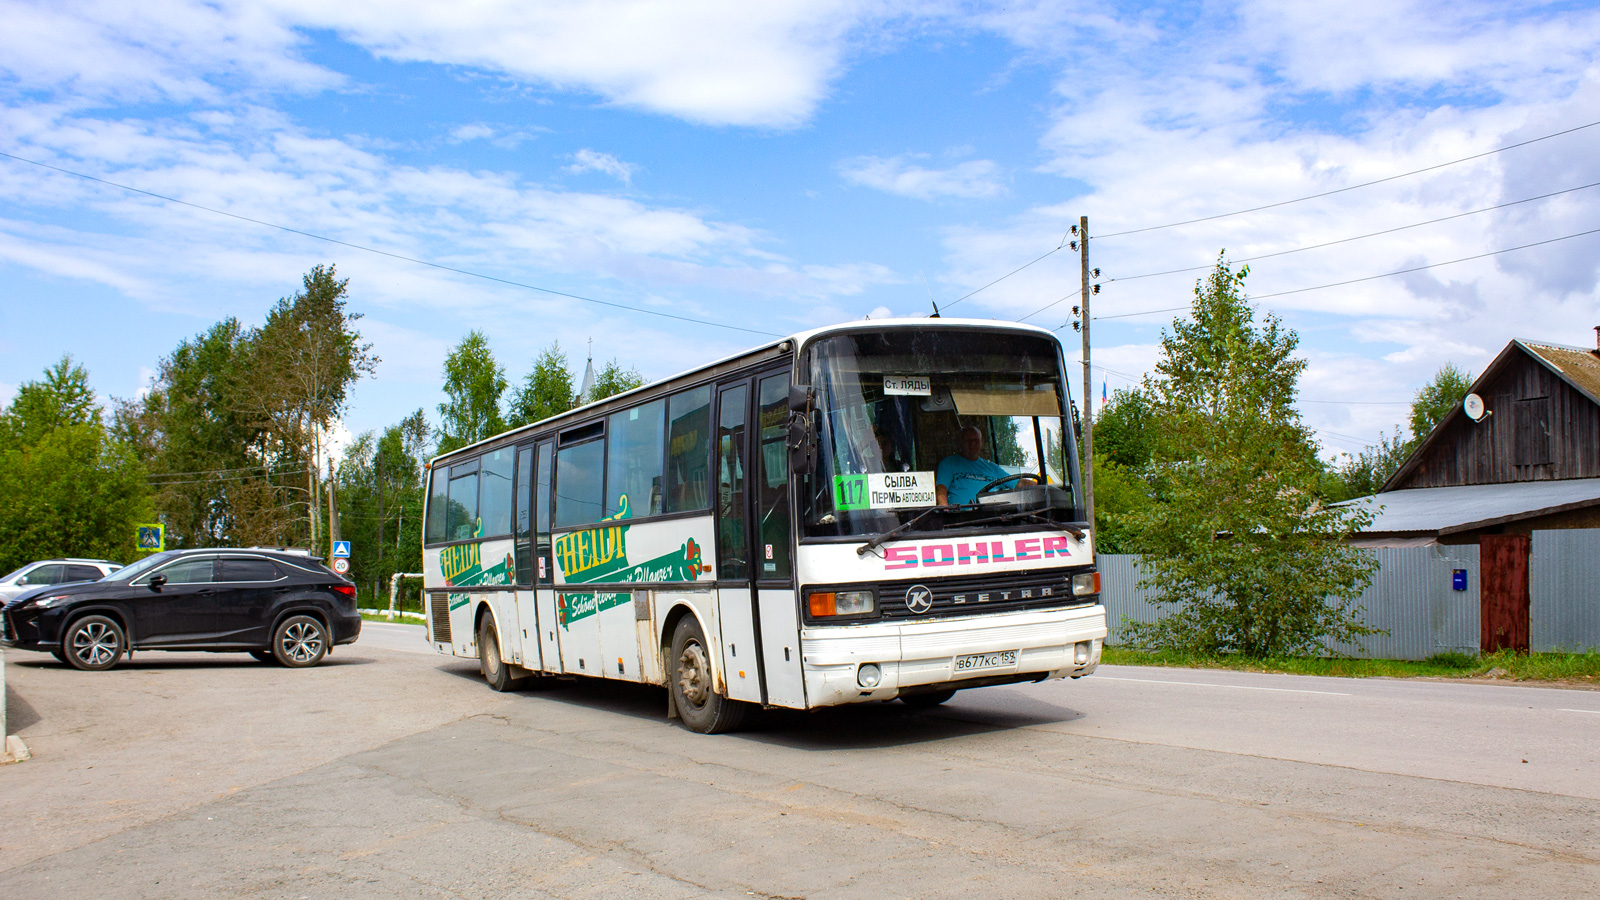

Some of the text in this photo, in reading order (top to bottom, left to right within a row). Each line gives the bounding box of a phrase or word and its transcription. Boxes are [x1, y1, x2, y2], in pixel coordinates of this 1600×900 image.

[884, 380, 930, 391] Ст. ЛЯДЫ
[884, 475, 918, 488] СЫЛВА
[838, 480, 864, 506] 117
[872, 491, 935, 505] ПЕРМЬ АВТОВОКЗАЛ
[556, 494, 627, 578] HEIDI
[440, 517, 481, 582] HEIDI
[884, 536, 1072, 571] SOHLER
[336, 562, 346, 570] 20
[954, 588, 1053, 605] SETRA
[958, 651, 1015, 669] В677КС 159
